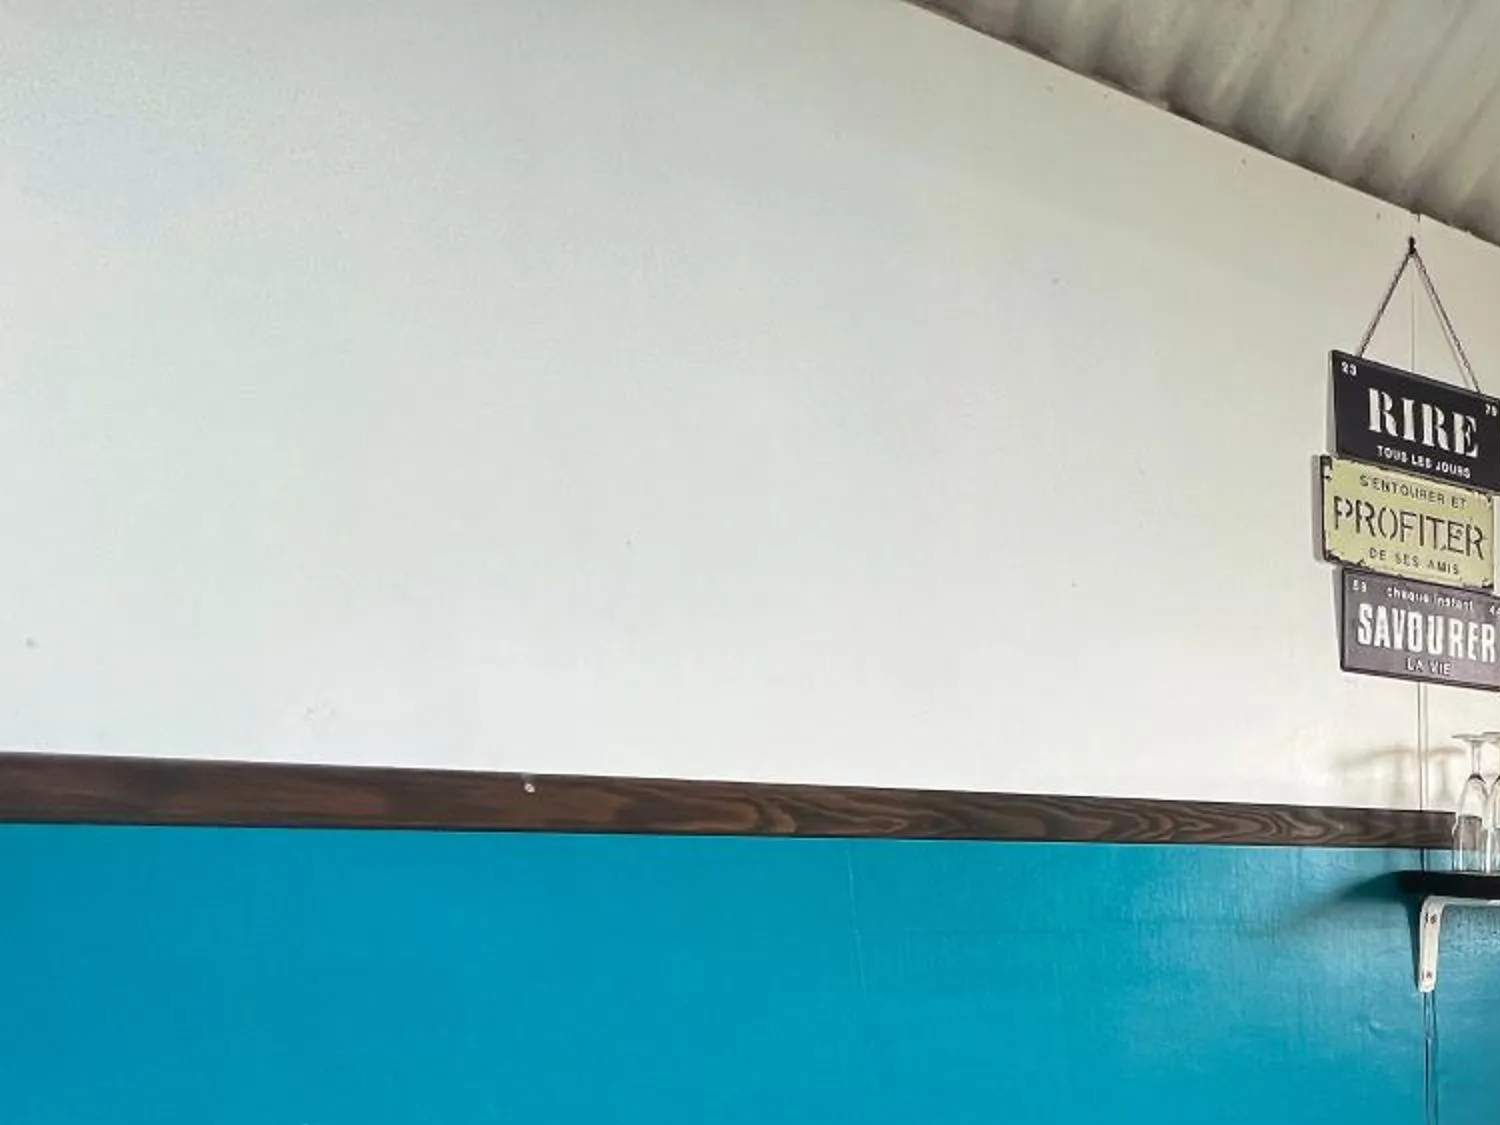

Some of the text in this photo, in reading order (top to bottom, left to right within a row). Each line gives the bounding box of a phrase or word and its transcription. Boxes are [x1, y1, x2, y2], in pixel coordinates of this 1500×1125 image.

[1368, 387, 1478, 459] RIRE
[1376, 445, 1471, 479] TOUS LES JOURS
[1451, 497, 1467, 510] ET
[1333, 495, 1485, 561] PROFITER
[1369, 547, 1460, 575] DE SES AMIS
[1357, 603, 1496, 664] SAVOURER
[1407, 657, 1451, 675] LA VIE
